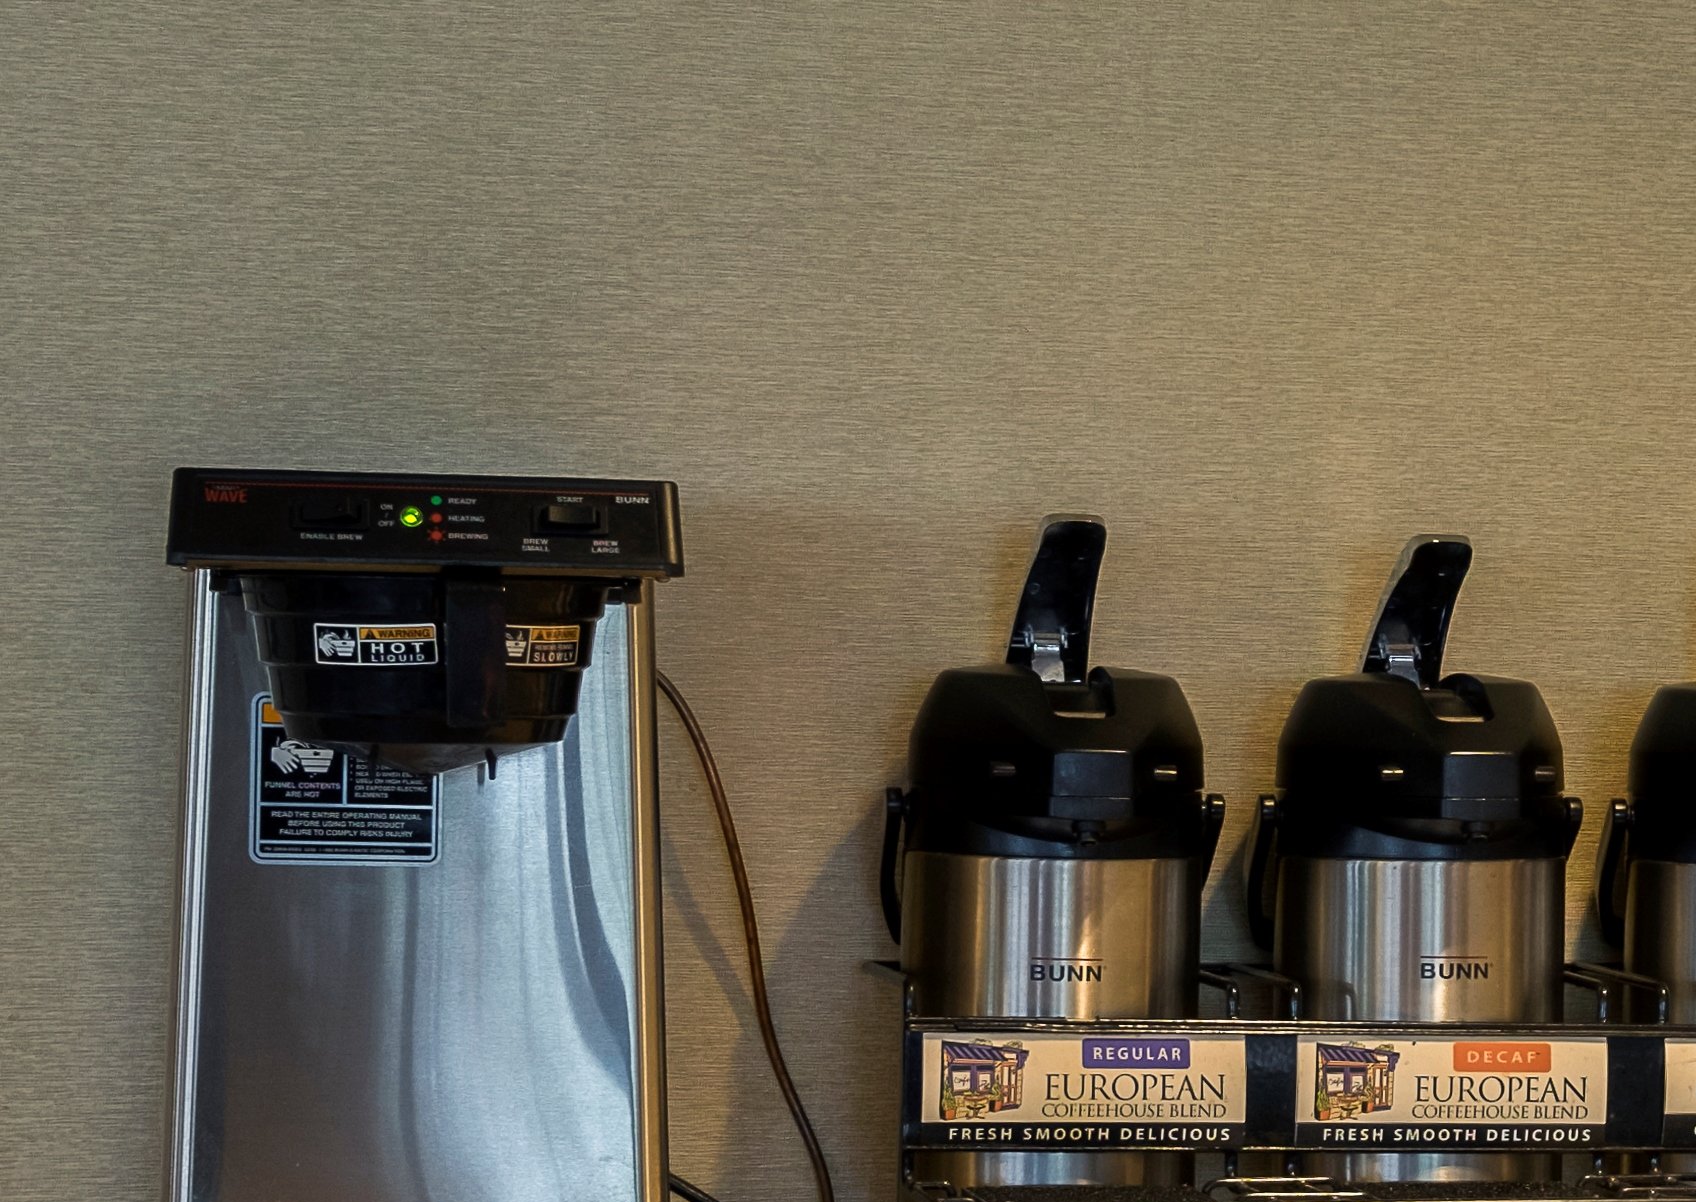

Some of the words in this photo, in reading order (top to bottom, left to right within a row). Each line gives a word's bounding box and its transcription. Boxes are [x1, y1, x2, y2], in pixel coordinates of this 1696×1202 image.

[205, 488, 248, 503] WAVE
[615, 496, 650, 504] BUNN
[300, 532, 335, 540] ENABLE
[337, 533, 363, 541] BREW
[379, 629, 431, 638] WARNING
[371, 642, 424, 654] HOT
[371, 654, 425, 662] LIQUID
[534, 652, 574, 662] SLOWLY
[264, 781, 296, 789] FUNNEL
[298, 782, 341, 790] CONTENTS
[312, 811, 340, 819] ENTIRE
[342, 812, 387, 820] OPERATING
[367, 821, 405, 829] PRODUCT
[279, 828, 312, 836] FAILURE
[313, 828, 324, 836] TO
[326, 829, 358, 837] COMPLY
[385, 830, 414, 838] INJURY
[1030, 964, 1102, 982] BUNN
[1421, 962, 1488, 980] BUNN
[1093, 1046, 1182, 1061] REGULAR
[1467, 1050, 1537, 1064] DECAF
[1045, 1073, 1226, 1101] EUROPEAN
[1414, 1075, 1588, 1103] EUROPEAN
[1041, 1102, 1164, 1118] COFFEEHOUSE
[1169, 1103, 1227, 1118] BLEND
[1411, 1104, 1529, 1120] COFFEEHOUSE
[1534, 1104, 1589, 1120] BLEND
[949, 1128, 1013, 1141] FRESH
[1023, 1128, 1110, 1141] SMOOTH
[1120, 1128, 1231, 1141] DELICIOUS
[1323, 1128, 1384, 1141] FRESH
[1393, 1128, 1477, 1142] SMOOTH
[1486, 1129, 1591, 1142] DELICIOUS
